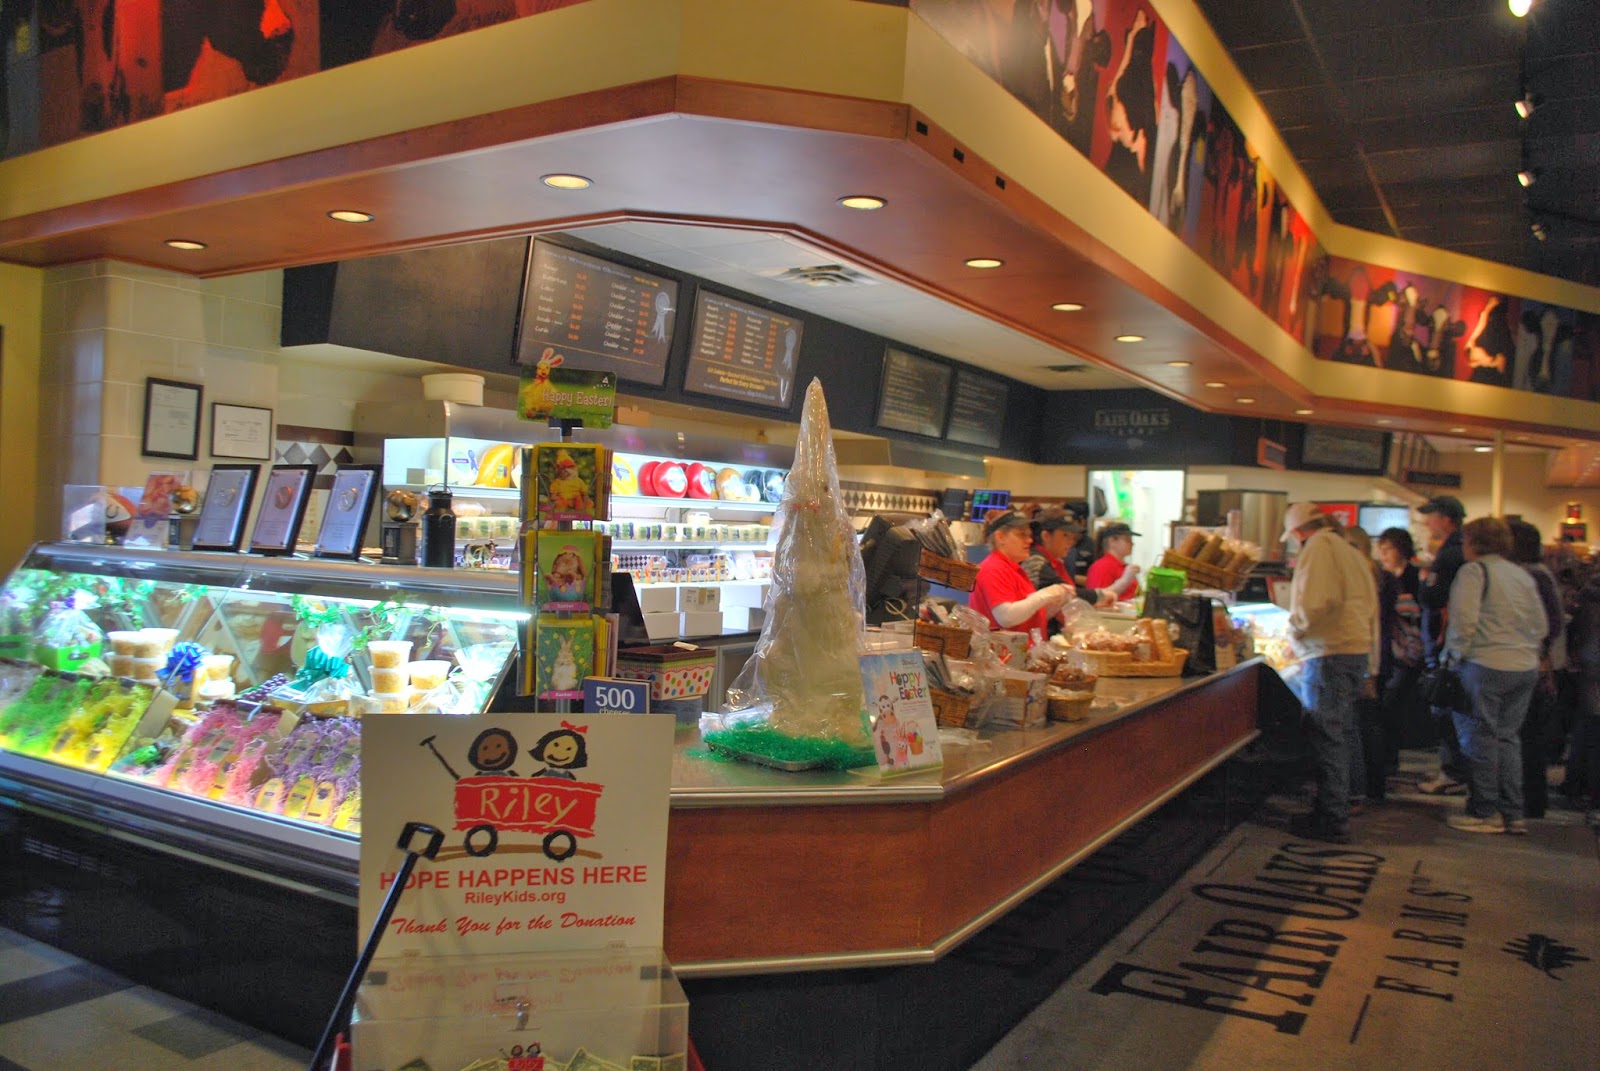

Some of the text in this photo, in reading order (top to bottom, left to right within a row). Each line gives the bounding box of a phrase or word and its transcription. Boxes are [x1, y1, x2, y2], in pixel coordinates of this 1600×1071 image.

[542, 388, 573, 407] Happy
[595, 686, 636, 710] 500
[480, 786, 578, 829] Riley
[458, 867, 575, 888] HAPPENS
[583, 865, 647, 884] HERE
[464, 891, 566, 906] RileyKids.org
[391, 912, 636, 936] Thank You for the Donation
[1090, 841, 1387, 1036] FAIR OAKS
[1374, 887, 1472, 1002] FARMS
